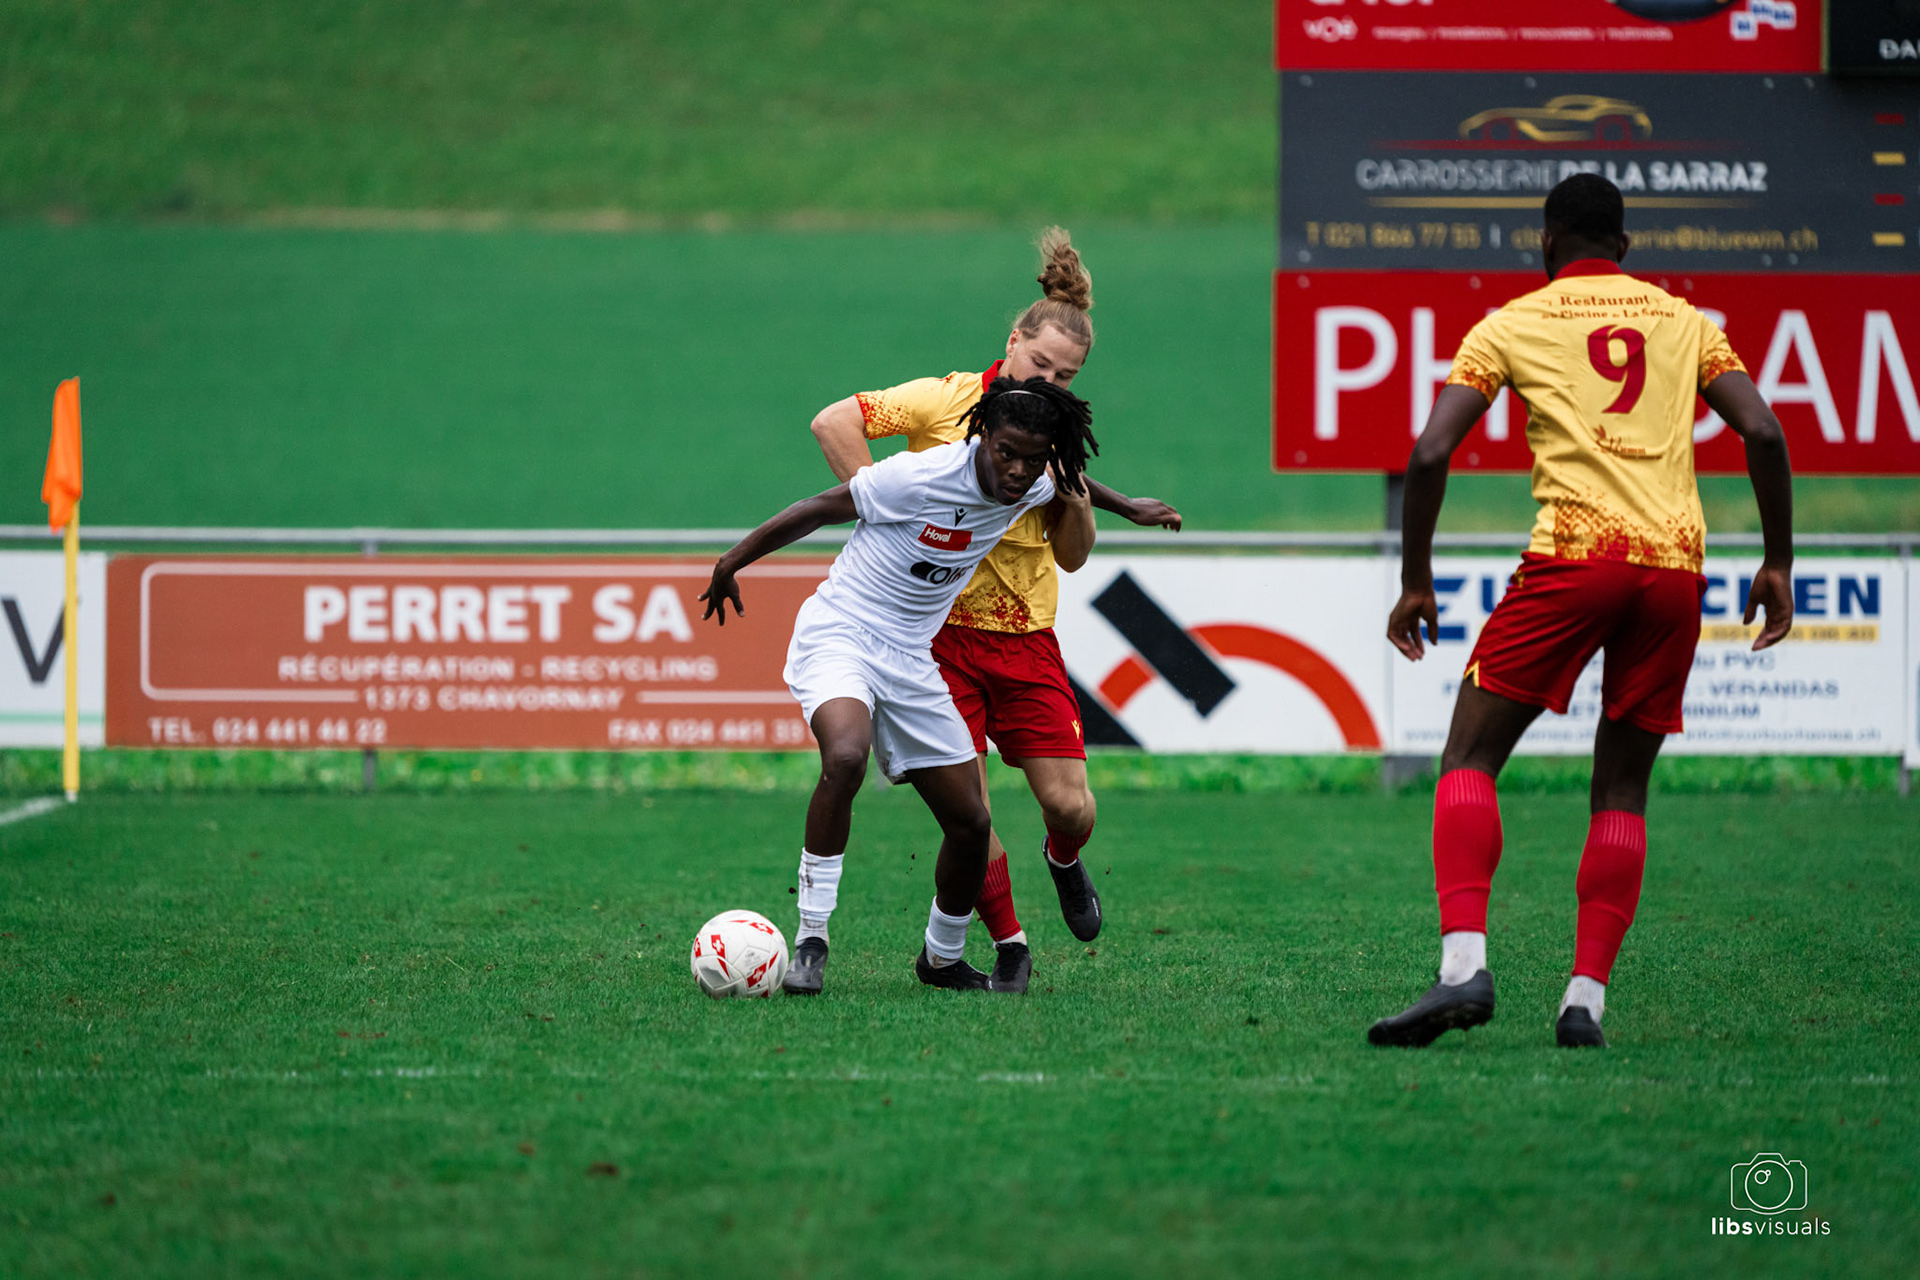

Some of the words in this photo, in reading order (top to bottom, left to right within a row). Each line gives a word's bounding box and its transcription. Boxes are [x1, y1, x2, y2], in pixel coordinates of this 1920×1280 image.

[1879, 38, 1920, 60] DA
[1604, 160, 1646, 191] LA
[1650, 160, 1768, 191] SARRAZ
[1560, 295, 1650, 306] Restaurant
[1587, 324, 1647, 414] 9
[924, 527, 951, 543] Hoval
[304, 585, 572, 643] PERRET
[592, 584, 694, 643] SA
[278, 653, 516, 682] RÉCUPÉRATION
[541, 656, 719, 682] RECYCLING
[1723, 651, 1776, 672] PVC
[365, 685, 431, 712] 1373
[437, 686, 625, 712] CHAVORNAY
[354, 716, 388, 745] 22
[608, 718, 662, 745] FAX
